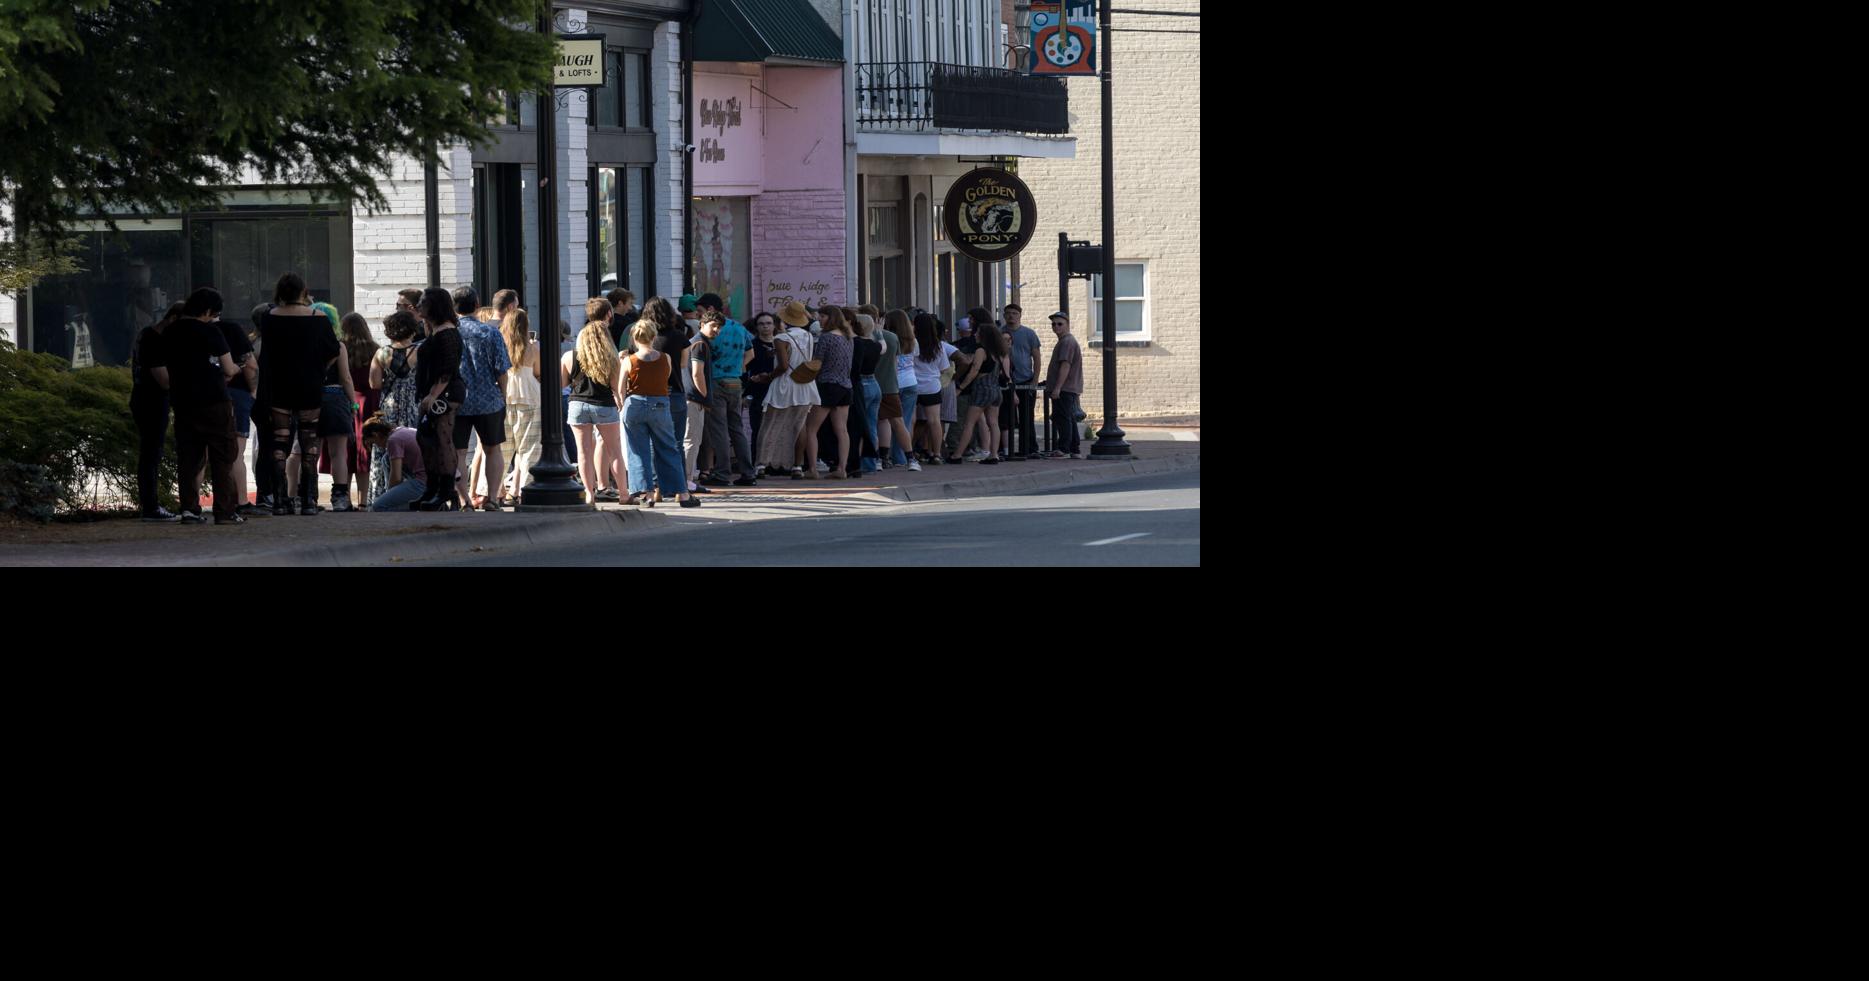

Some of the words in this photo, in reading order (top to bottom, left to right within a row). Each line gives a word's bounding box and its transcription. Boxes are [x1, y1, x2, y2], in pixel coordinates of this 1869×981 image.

[558, 54, 594, 67] AUGH
[568, 69, 592, 77] LOFTS
[965, 185, 1016, 202] GOLDEN
[968, 234, 1013, 243] PONY
